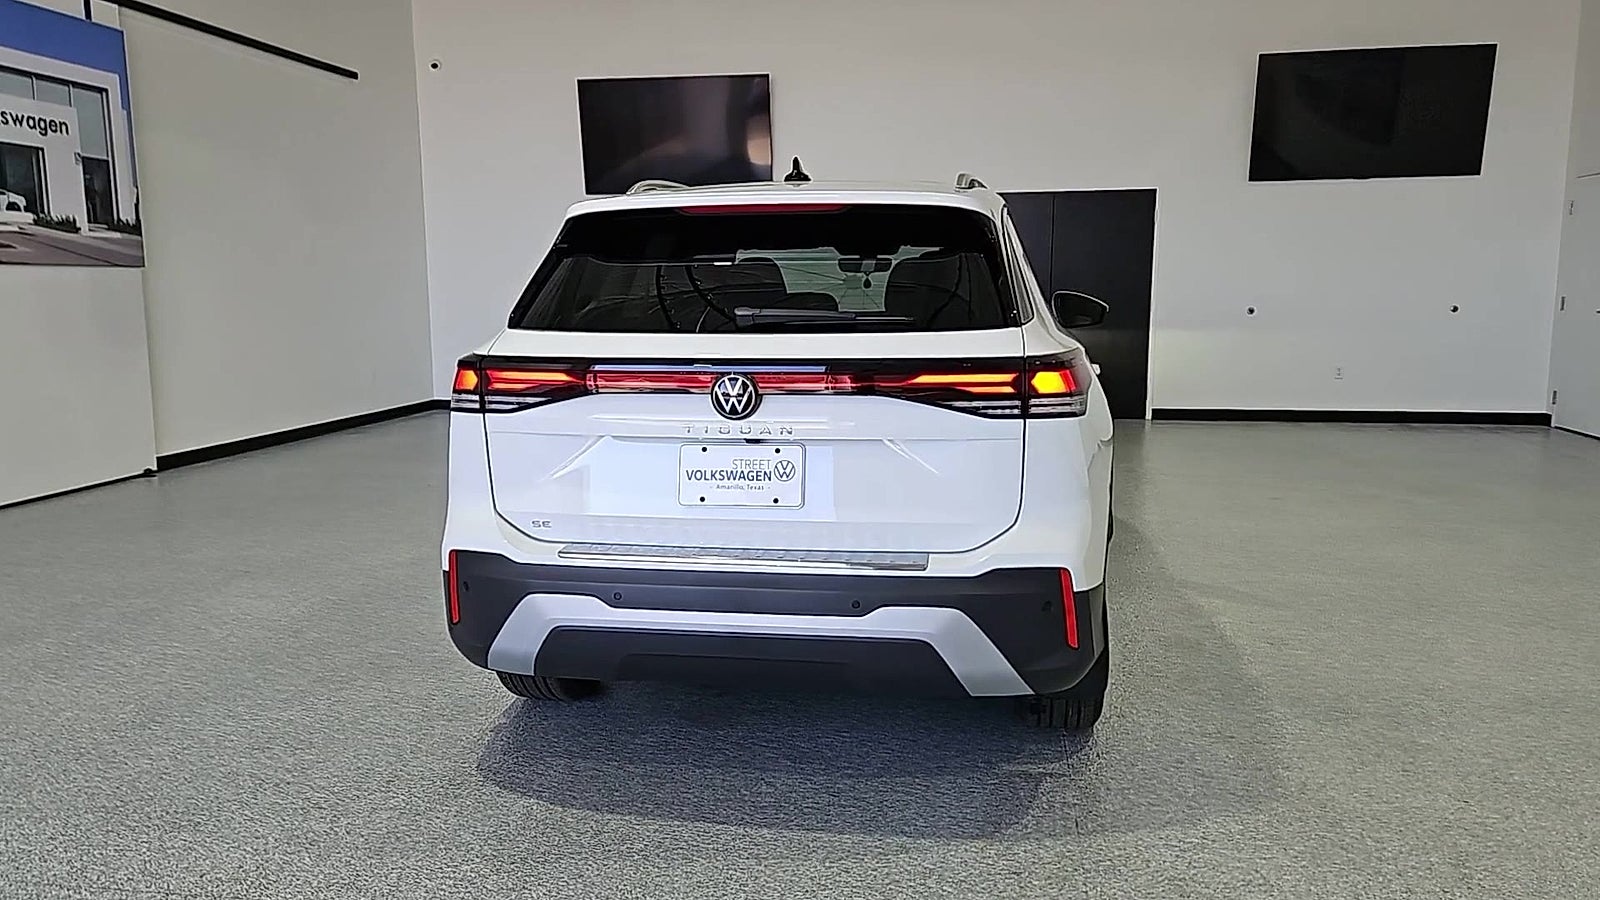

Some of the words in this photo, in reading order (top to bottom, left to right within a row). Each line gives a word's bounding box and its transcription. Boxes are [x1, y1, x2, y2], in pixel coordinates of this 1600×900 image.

[0, 110, 69, 136] swagen
[682, 424, 794, 436] TIGUAN
[732, 459, 772, 470] STREET
[686, 470, 772, 482] VOLKSWAGEN
[531, 520, 552, 528] SE
